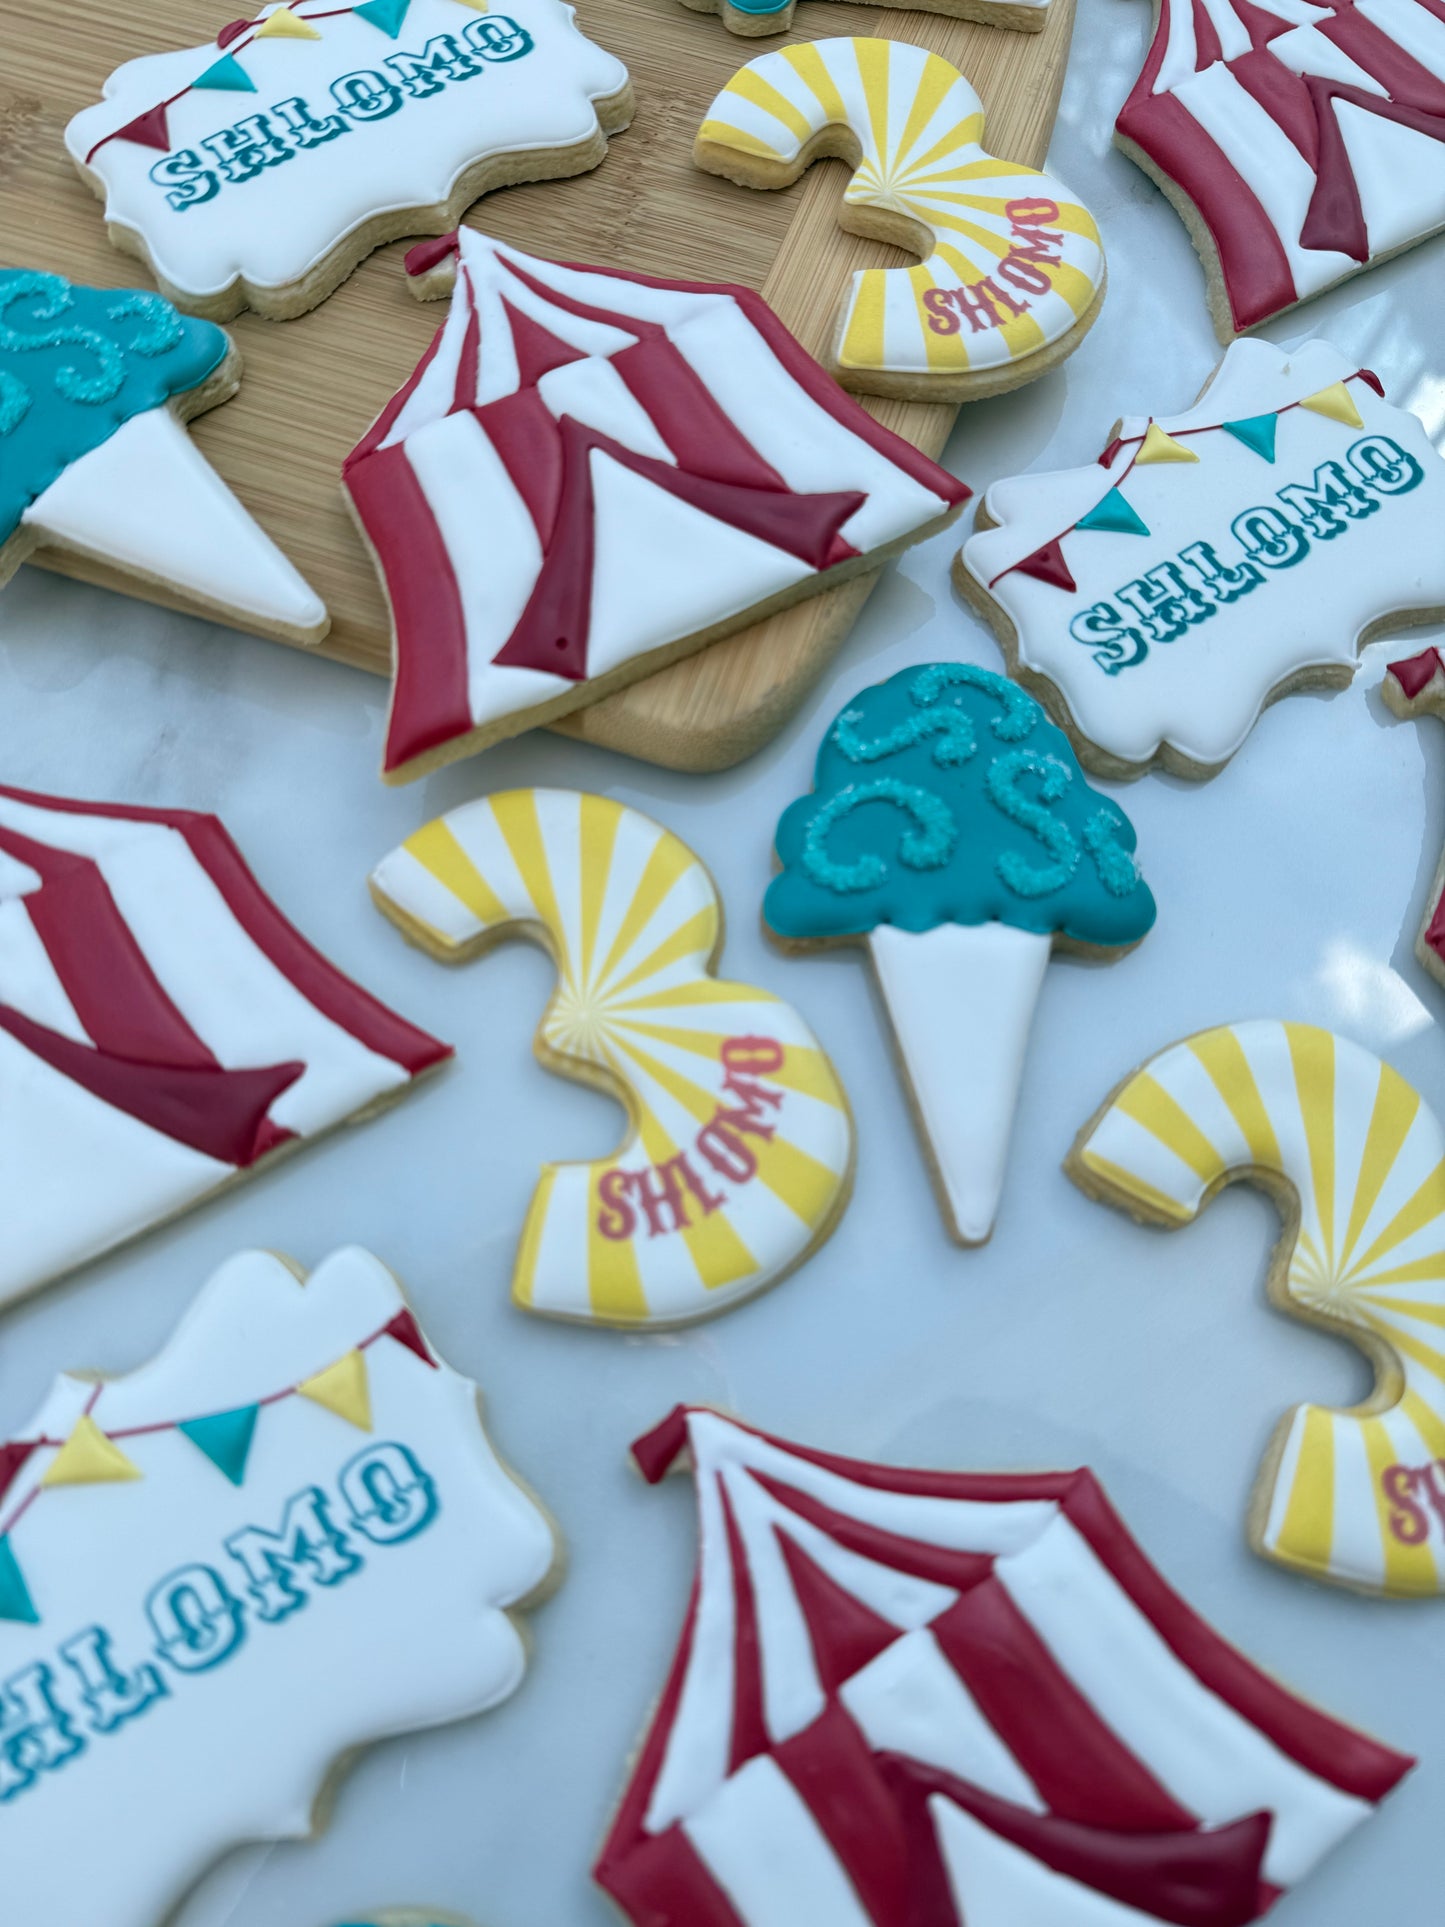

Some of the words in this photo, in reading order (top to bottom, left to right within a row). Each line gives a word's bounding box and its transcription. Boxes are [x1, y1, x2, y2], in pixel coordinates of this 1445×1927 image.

[149, 14, 534, 212] SHLOMO
[923, 197, 1065, 337] SHLOMO
[1068, 435, 1425, 675] SHLOMO
[597, 1034, 785, 1241] SHLOMO
